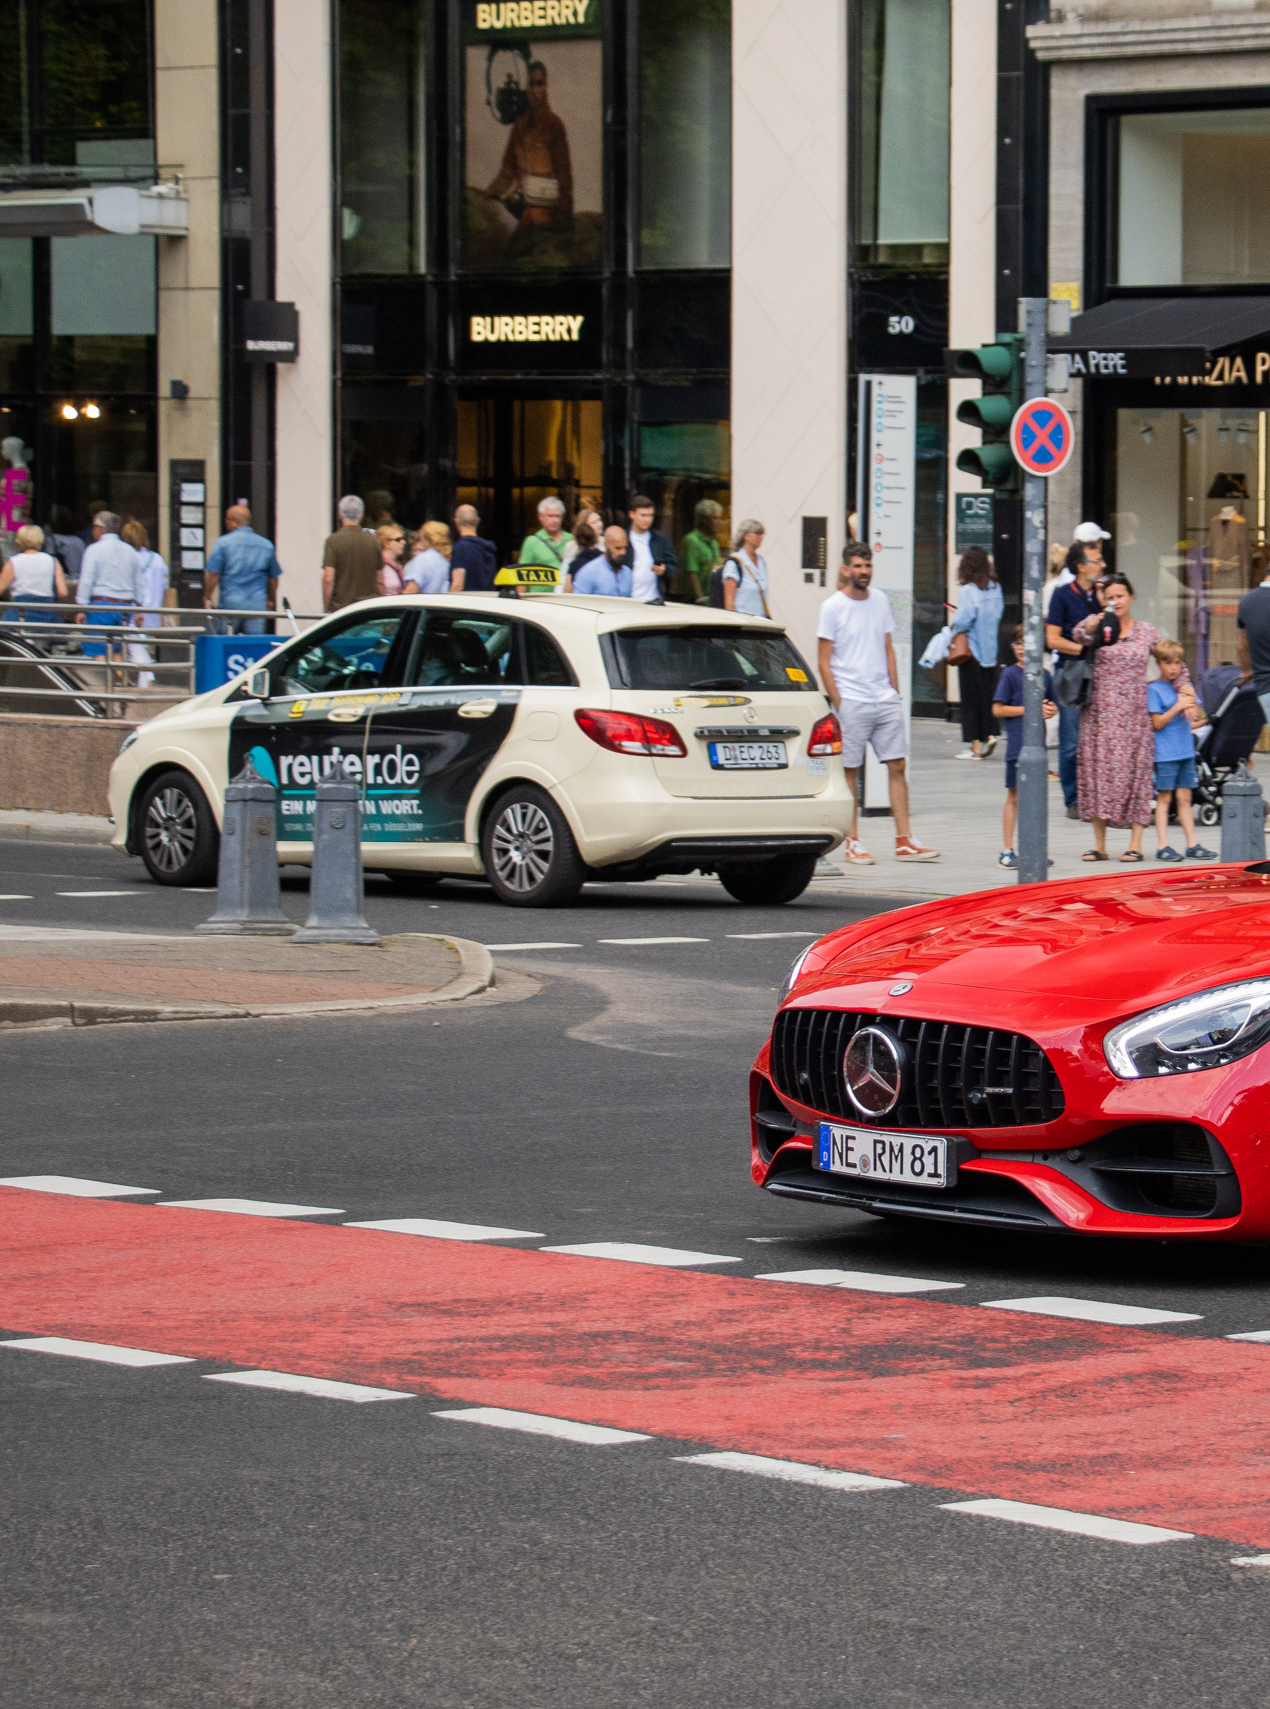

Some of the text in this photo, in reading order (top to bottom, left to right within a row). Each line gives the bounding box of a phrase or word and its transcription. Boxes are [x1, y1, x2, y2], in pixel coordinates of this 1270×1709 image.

[477, 0, 589, 29] BURBERRY
[471, 315, 584, 342] BURBERRY
[888, 315, 914, 335] 50
[1088, 350, 1128, 374] PEPE
[520, 570, 553, 581] TAXI
[722, 745, 780, 761] D EC 263
[281, 800, 303, 815] EIN
[379, 800, 423, 815] WORT.
[832, 1132, 942, 1178] NE RM 81
